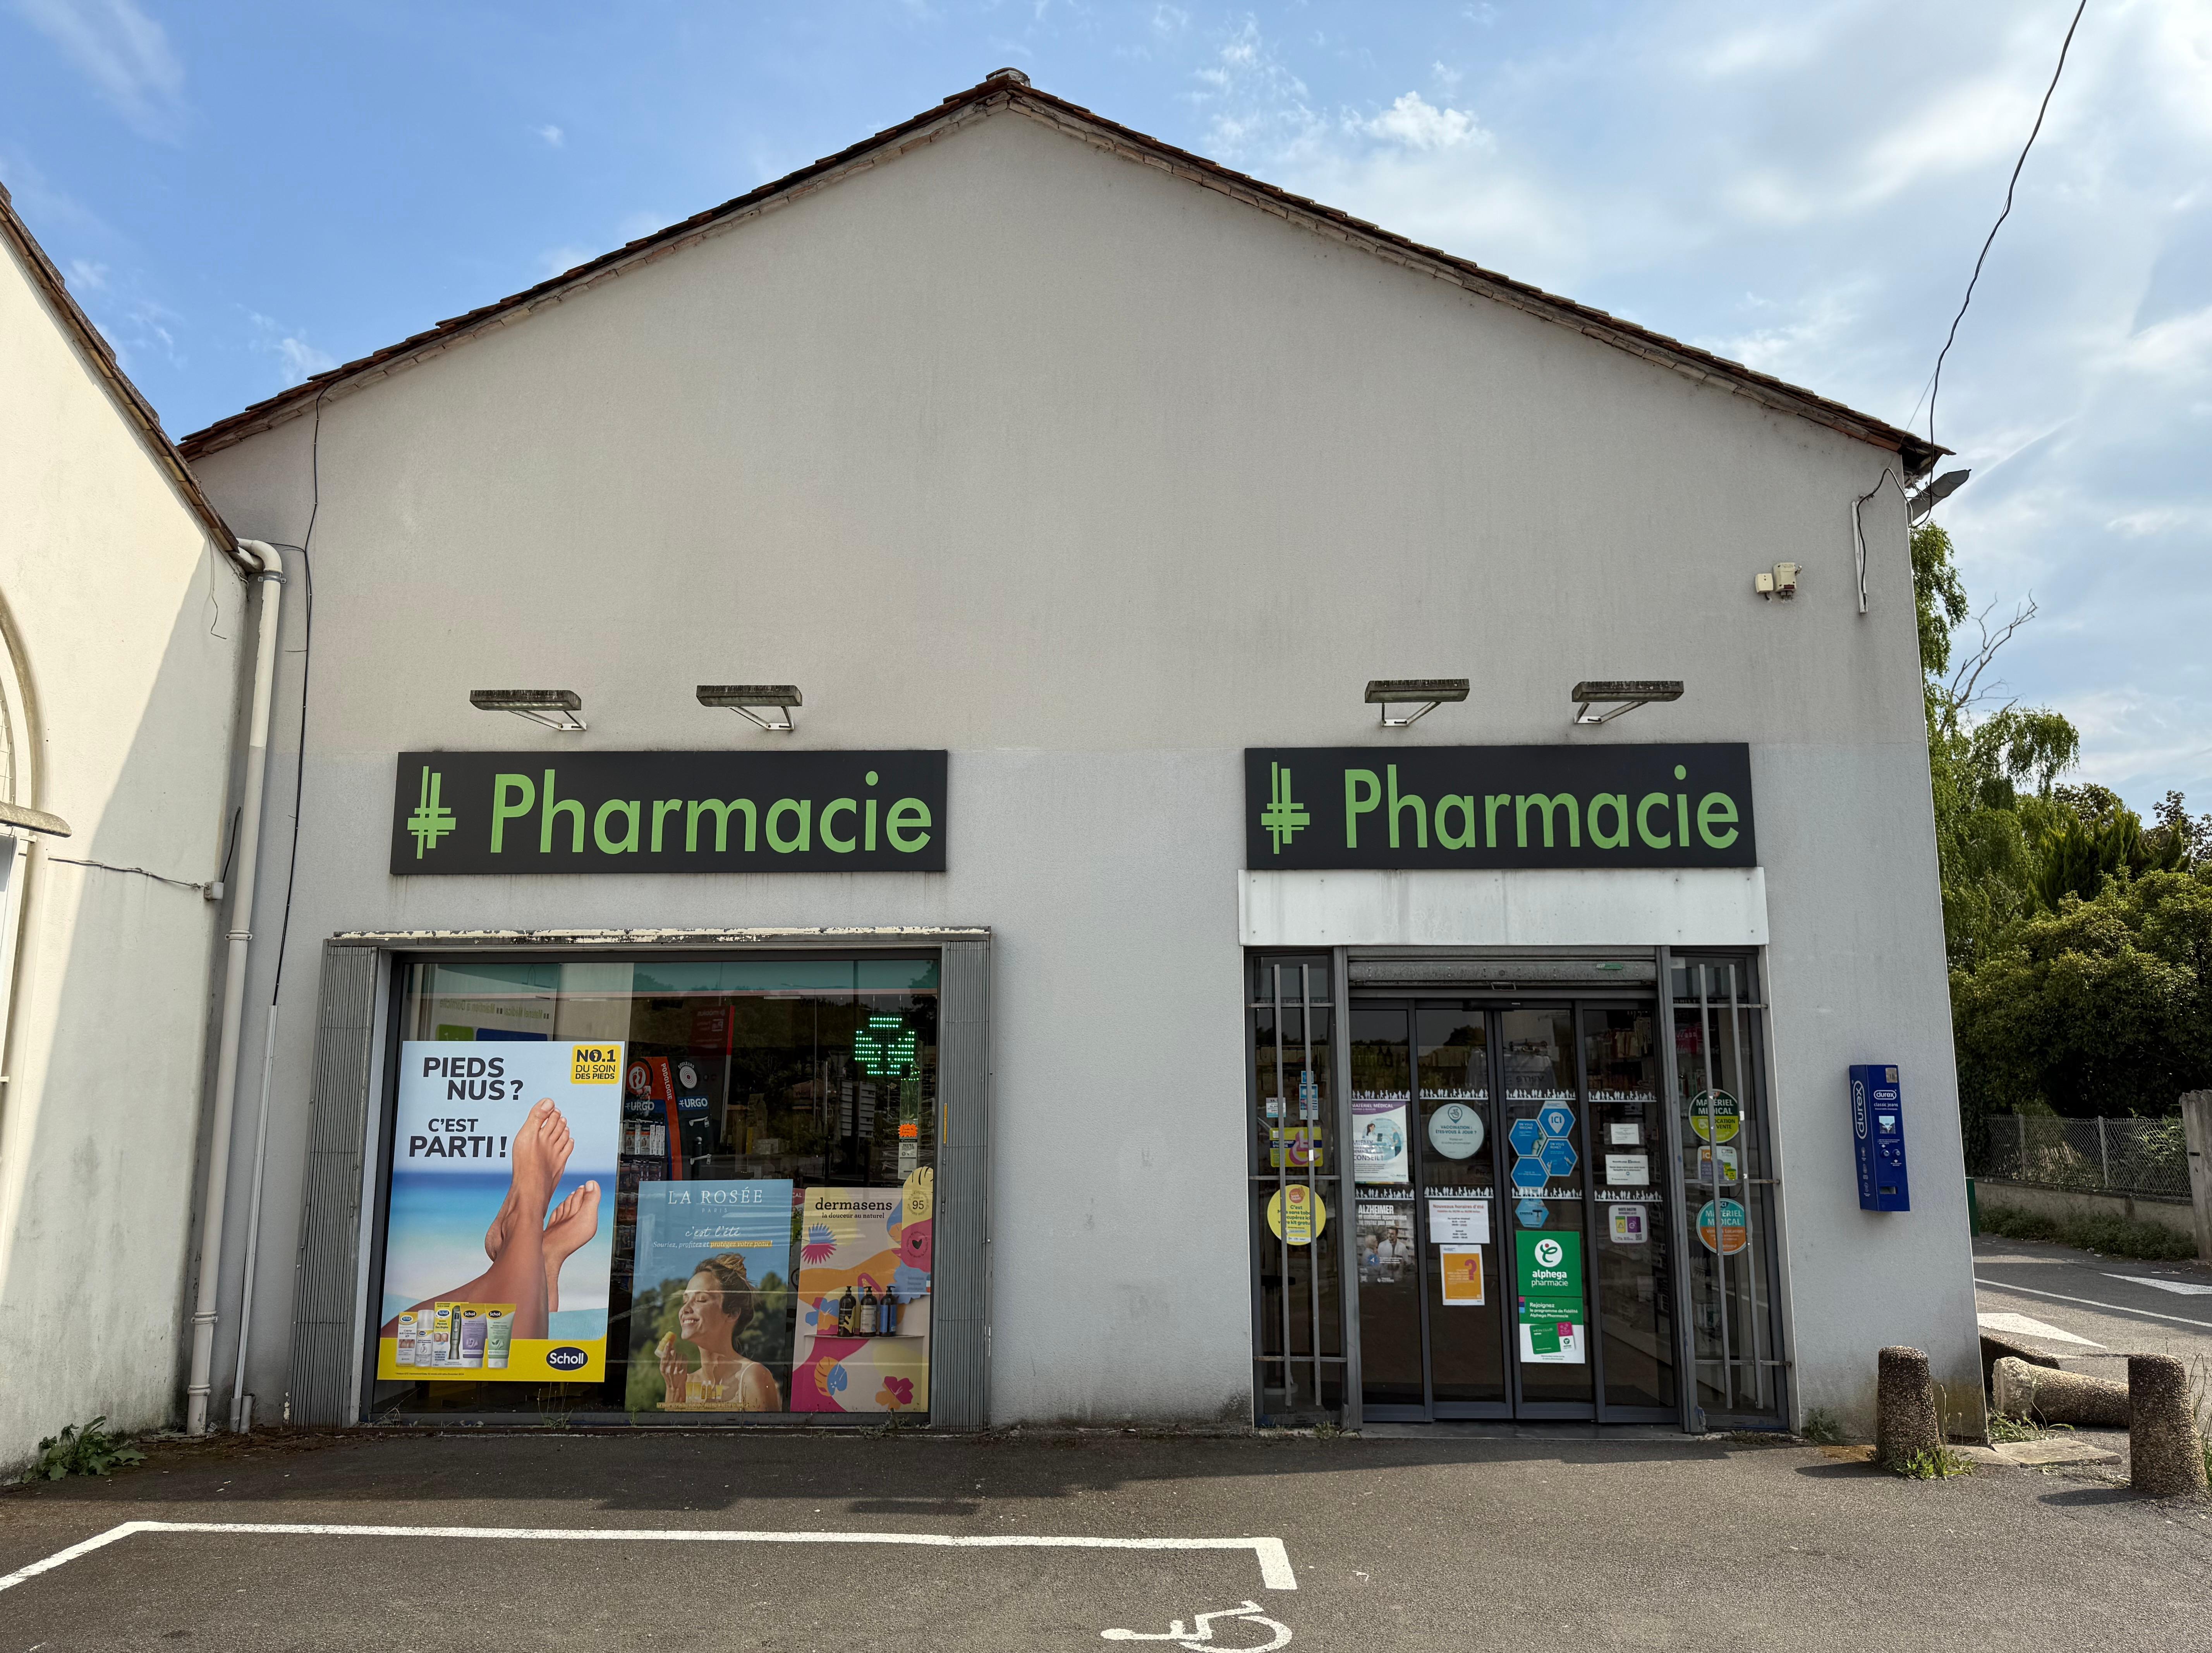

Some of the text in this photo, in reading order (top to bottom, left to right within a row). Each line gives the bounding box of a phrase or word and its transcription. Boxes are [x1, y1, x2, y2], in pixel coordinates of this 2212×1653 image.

[490, 769, 932, 854] Pharmacie
[1344, 764, 1739, 850] Pharmacie
[423, 1057, 504, 1077] PIEDS
[592, 1064, 615, 1072] SOIN
[661, 1063, 672, 1101] PODOLOGIE
[447, 1079, 524, 1100] NUS ?
[630, 1101, 654, 1111] URGO
[684, 1098, 708, 1108] URGO
[1856, 1085, 1865, 1133] durex
[428, 1118, 479, 1132] C'EST
[409, 1136, 508, 1158] PARTI !
[668, 1186, 763, 1204] LA ROSÉE
[815, 1197, 892, 1210] dermasens
[912, 1200, 924, 1210] 95
[1358, 1205, 1394, 1214] ALZHEIMER
[685, 1225, 741, 1237] c'est l'été
[1532, 1269, 1567, 1280] alphega
[1531, 1278, 1568, 1288] pharmacie
[549, 1352, 584, 1364] Scholl
